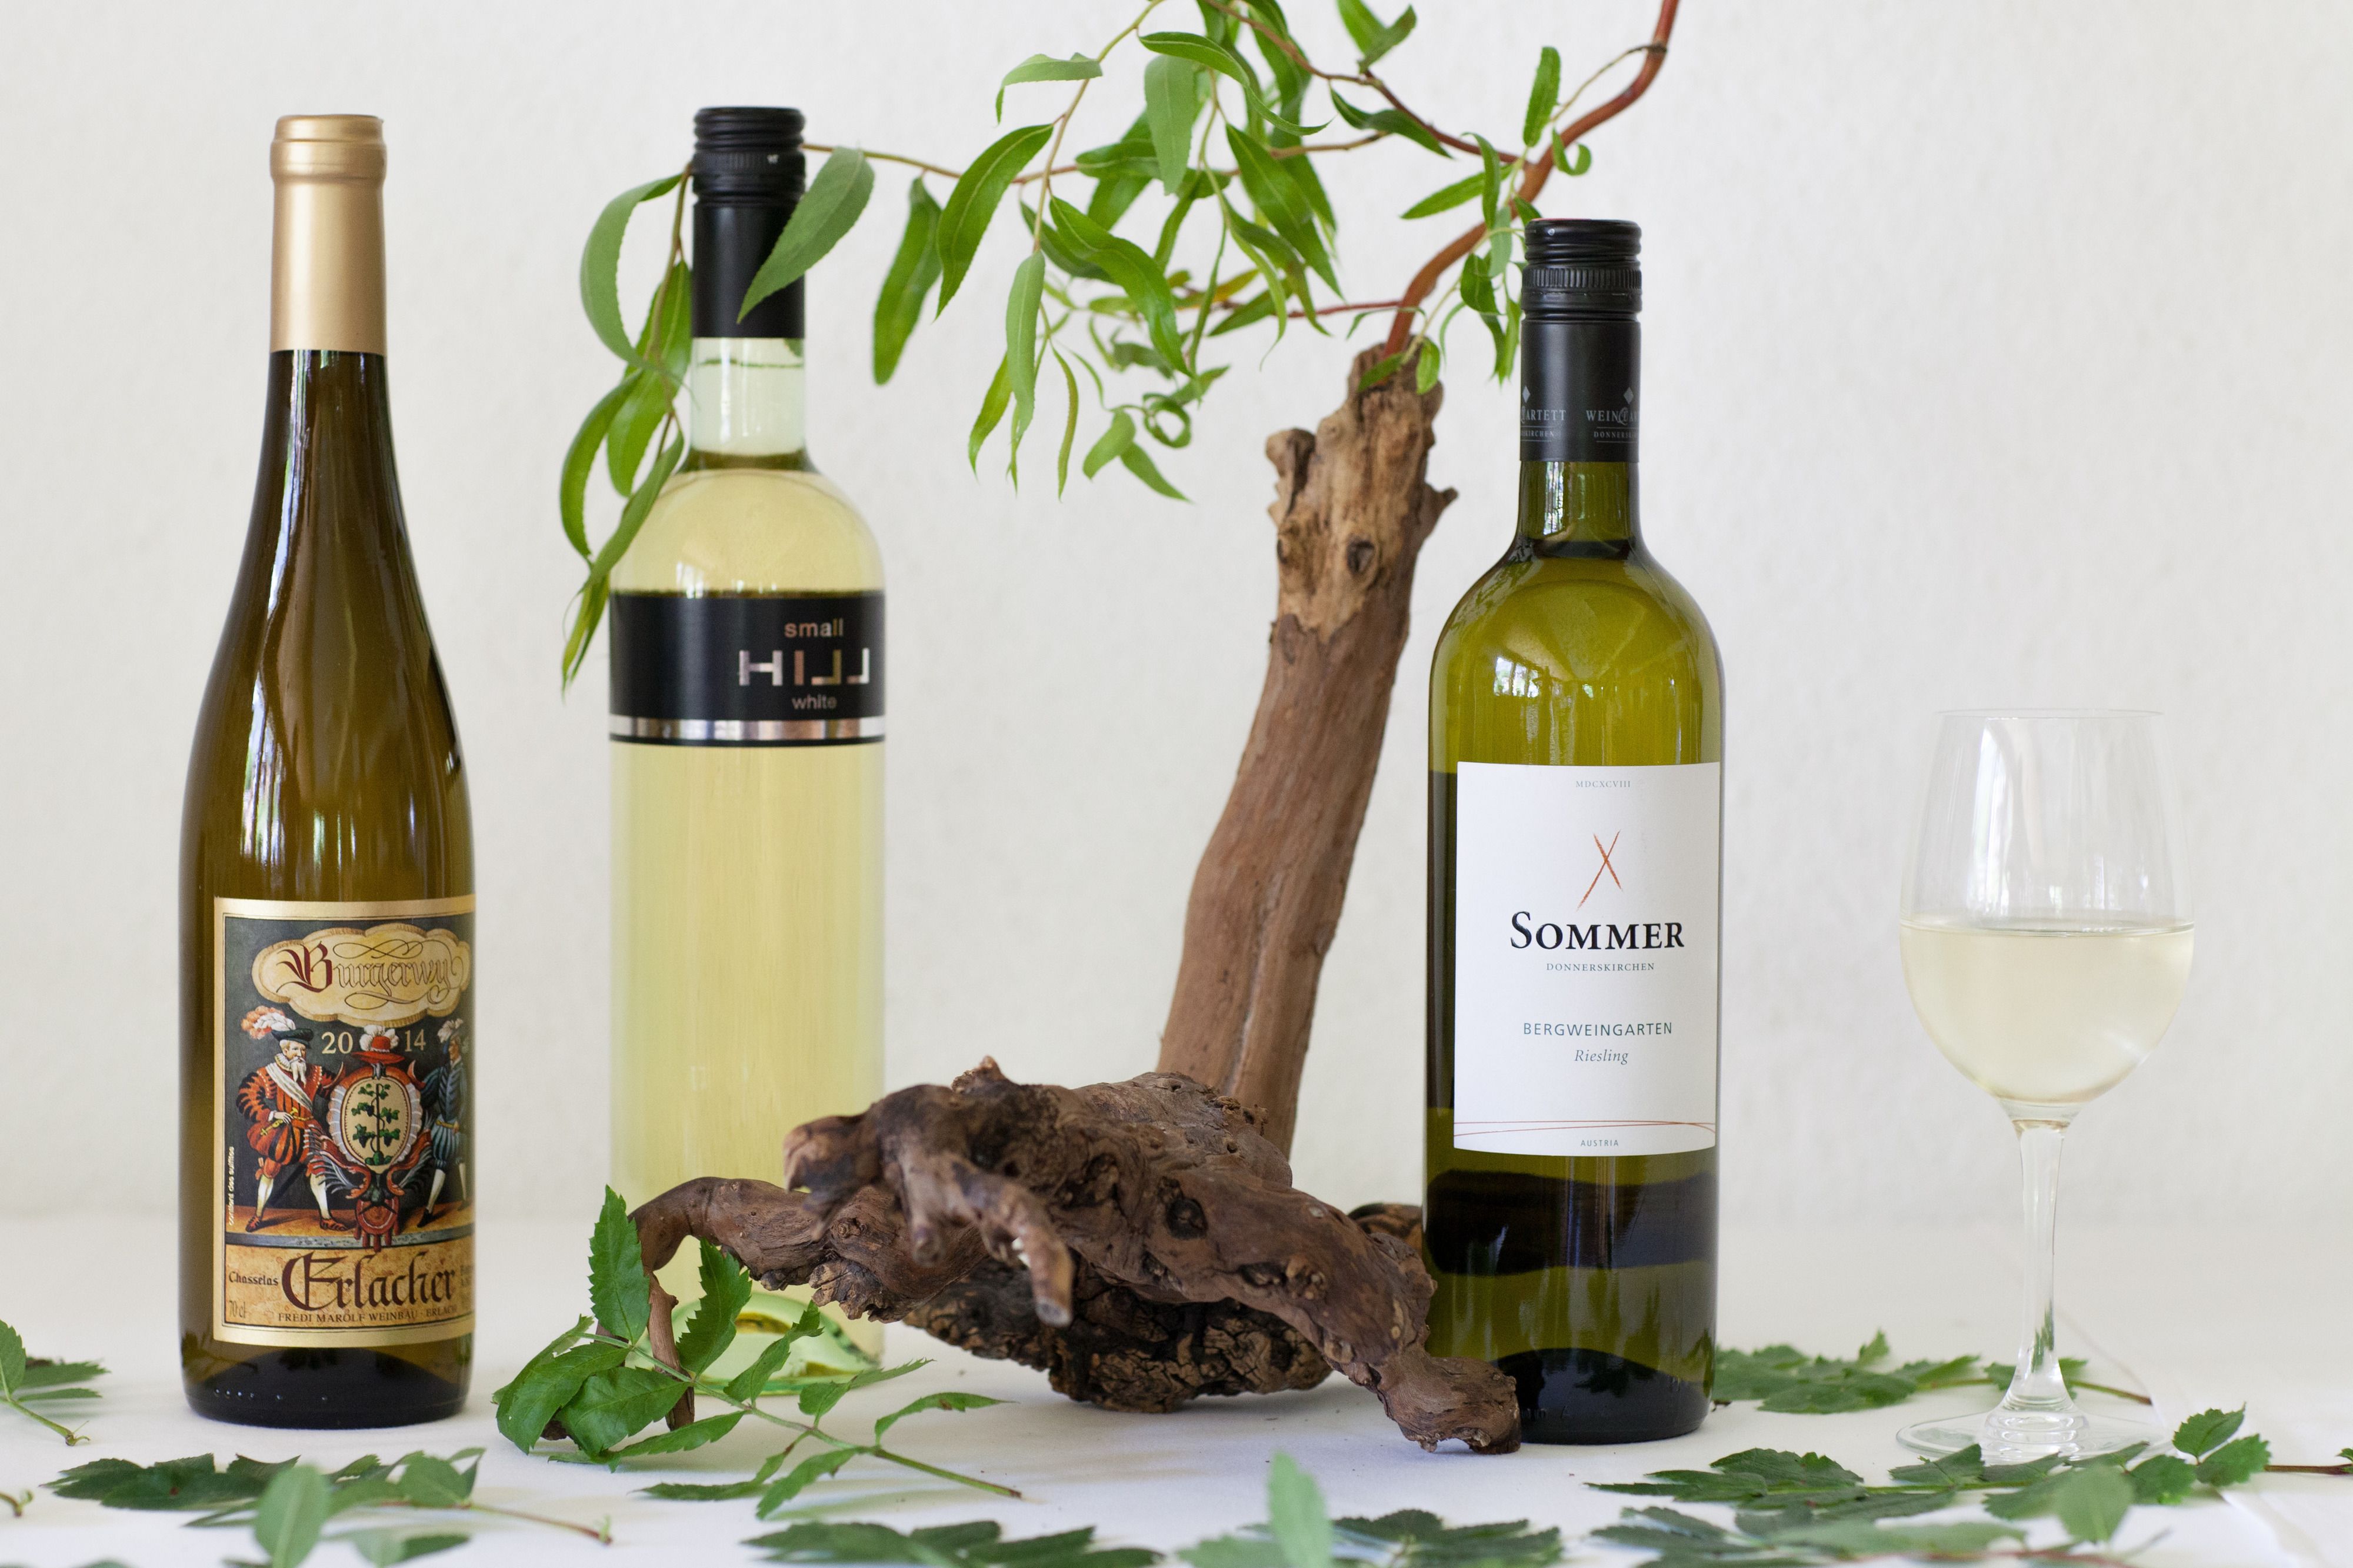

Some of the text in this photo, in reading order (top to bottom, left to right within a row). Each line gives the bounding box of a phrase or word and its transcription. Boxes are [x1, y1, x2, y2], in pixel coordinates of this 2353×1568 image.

[784, 618, 844, 638] small
[792, 695, 837, 710] white
[1510, 911, 1685, 950] SOMMER
[1546, 963, 1655, 972] DONNERSKIRCHEN
[1524, 1022, 1672, 1036] BERGWEINGARTEN
[321, 1029, 426, 1054] 20 14
[1574, 1049, 1629, 1065] Riesling
[229, 1271, 279, 1286] Chasselas
[282, 1250, 455, 1312] Erlacher
[278, 1312, 312, 1322] FREDI
[316, 1313, 365, 1322] MAROLF
[368, 1310, 418, 1322] WEINBAU
